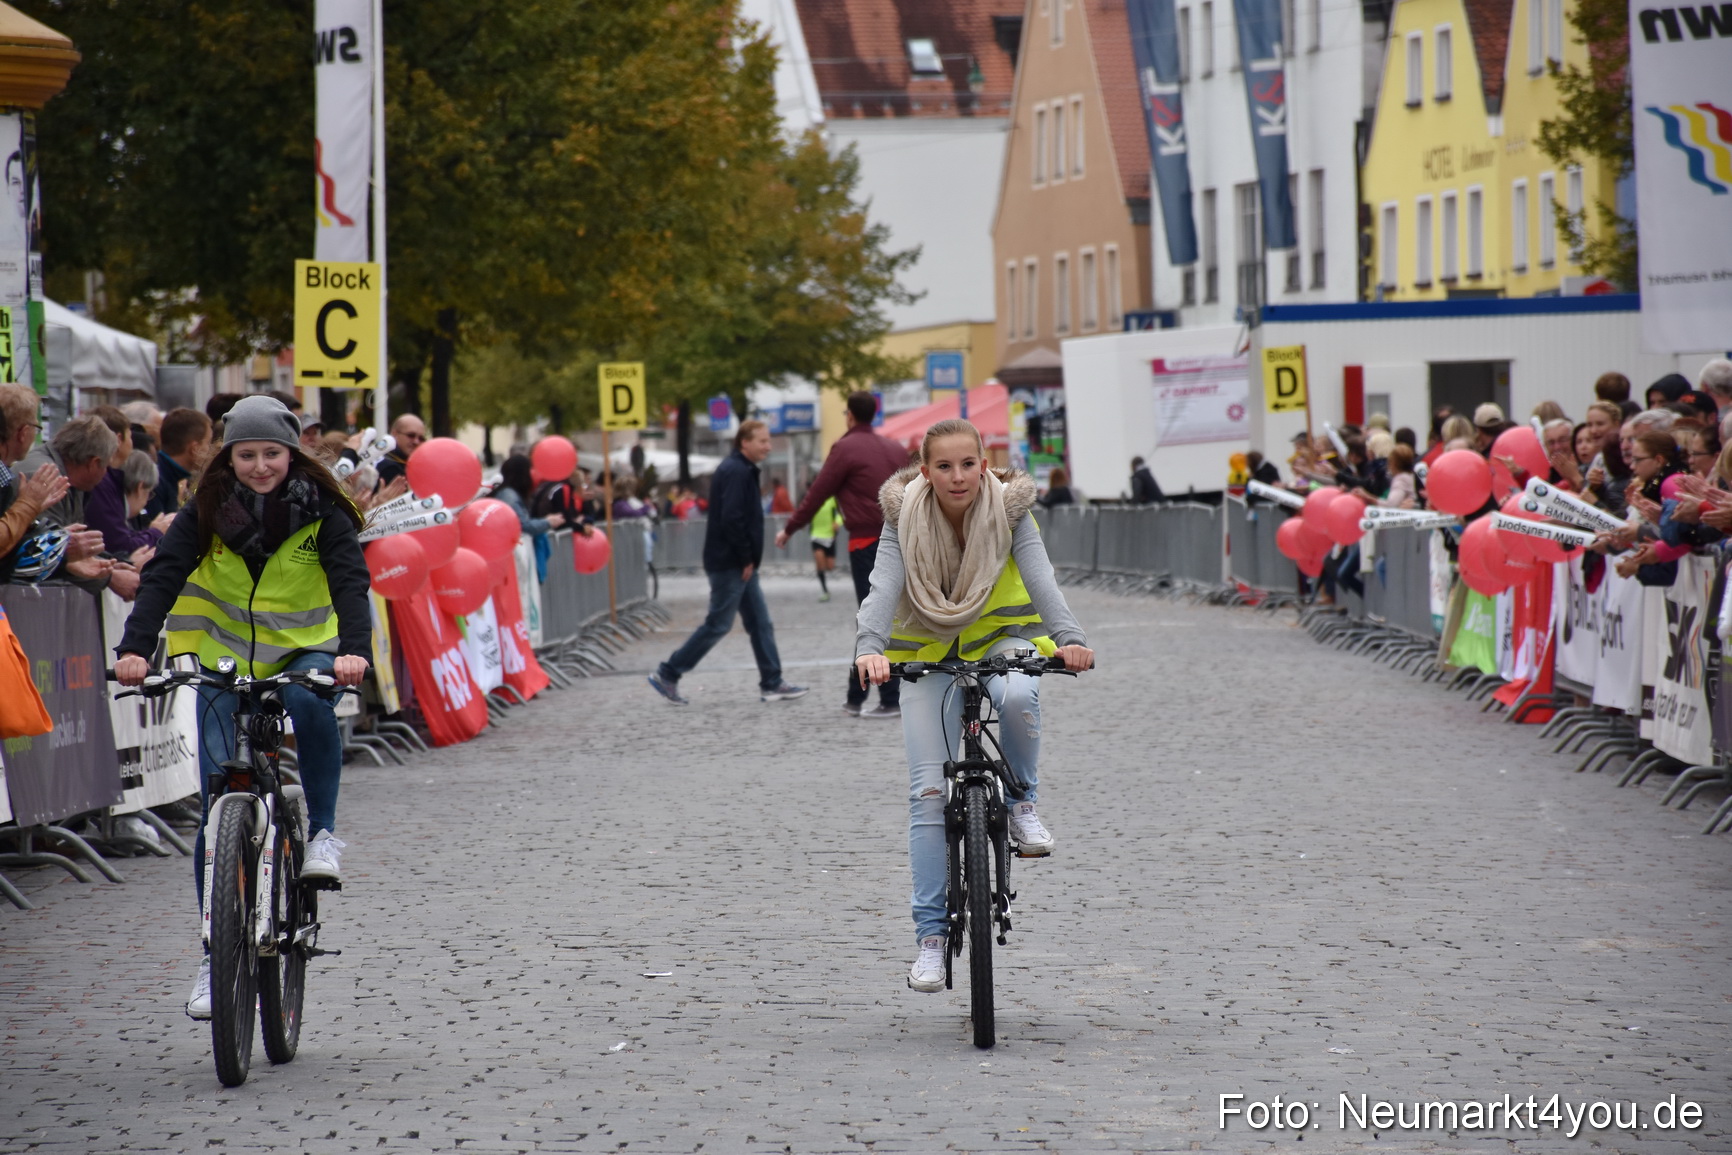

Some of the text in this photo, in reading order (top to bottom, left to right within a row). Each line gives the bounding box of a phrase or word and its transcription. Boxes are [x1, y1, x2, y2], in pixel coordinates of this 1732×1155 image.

[306, 266, 370, 290] Block
[316, 299, 358, 360] C
[1267, 350, 1303, 363] Block
[604, 367, 638, 379] Block
[1275, 366, 1298, 397] D
[612, 384, 634, 414] D
